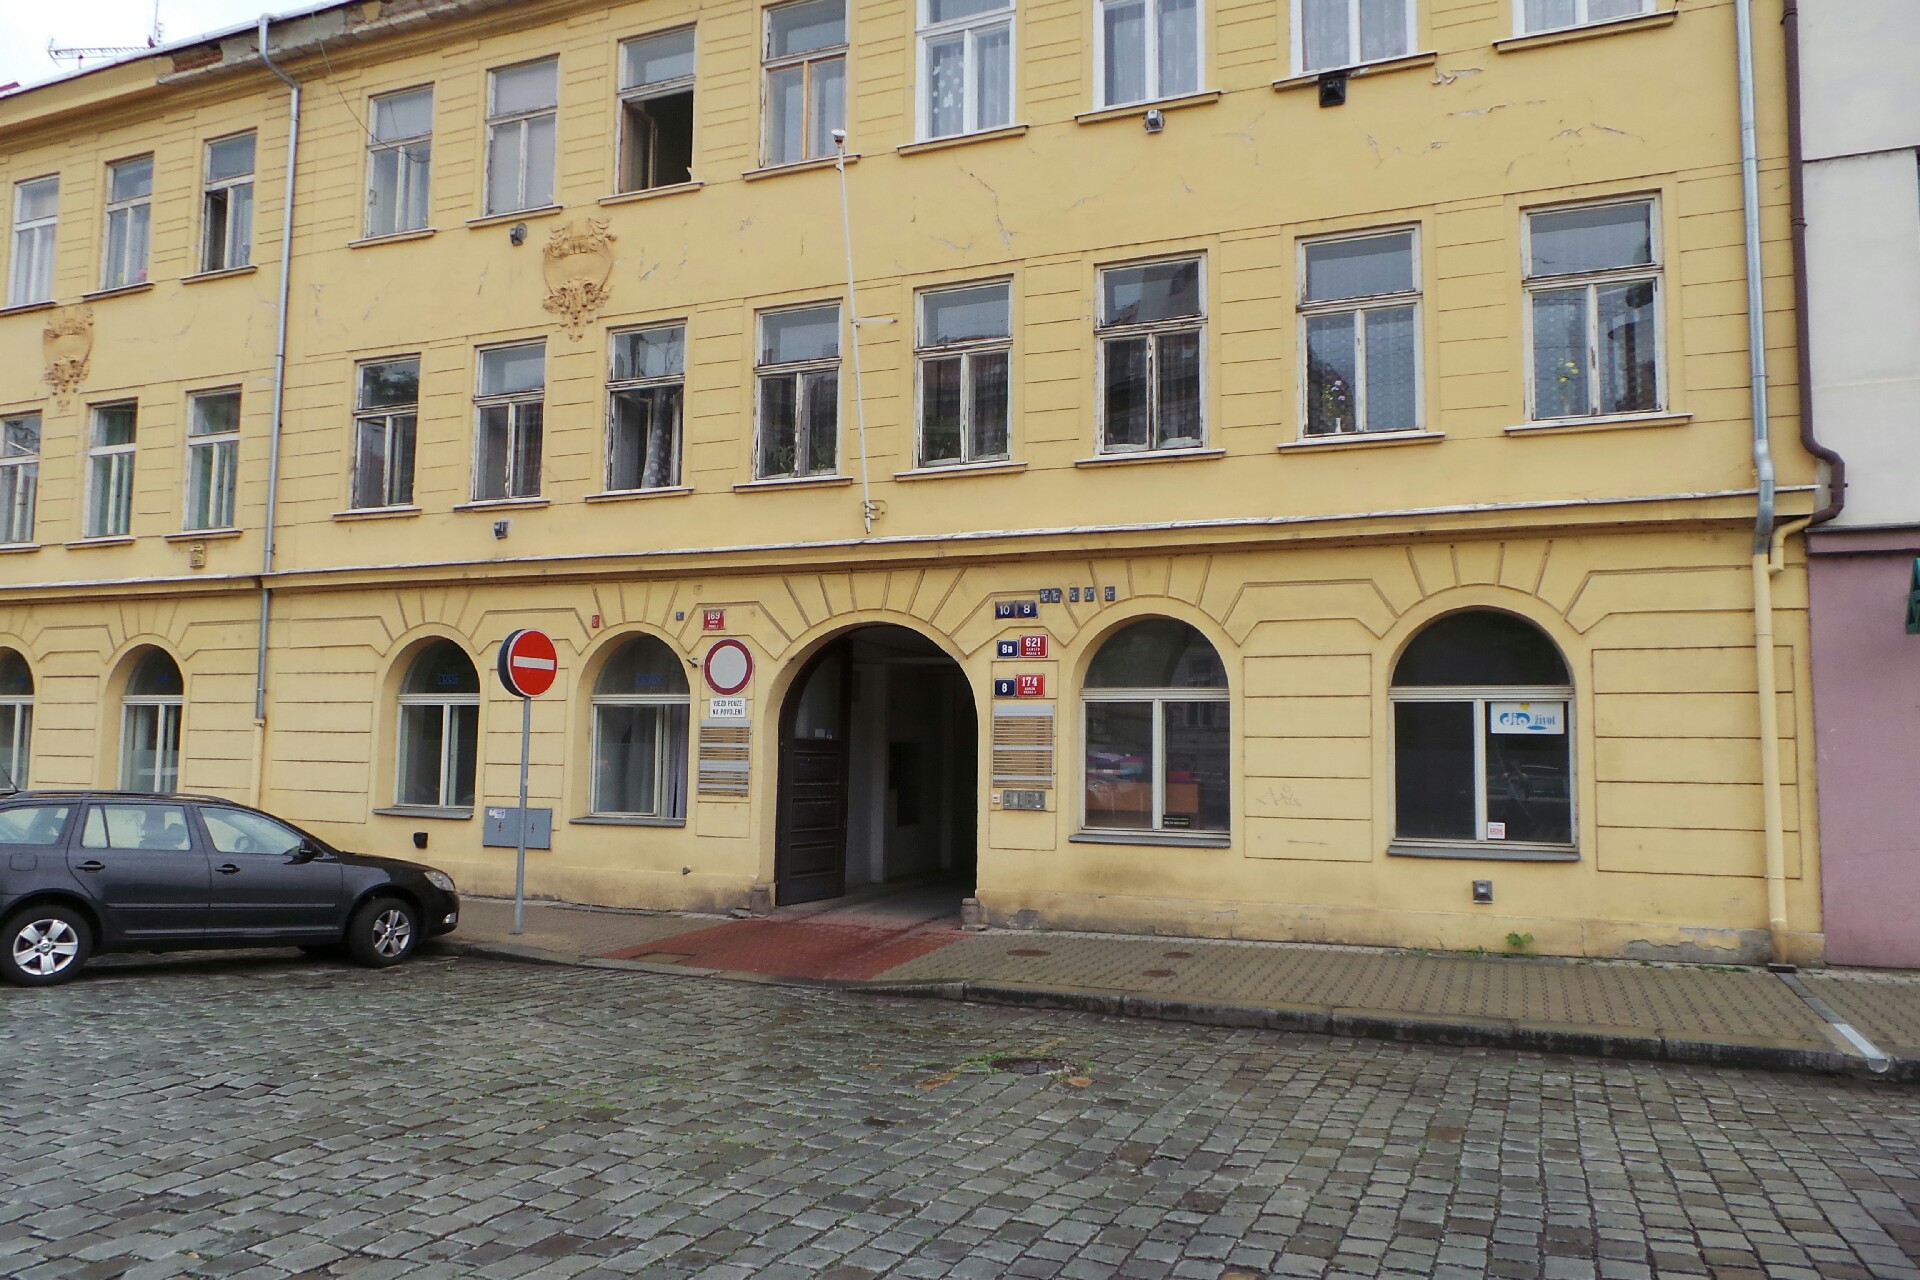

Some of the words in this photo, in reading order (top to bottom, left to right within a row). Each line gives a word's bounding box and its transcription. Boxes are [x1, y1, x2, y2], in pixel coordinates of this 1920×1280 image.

[1000, 606, 1010, 614] 10
[1023, 604, 1030, 614] 8
[708, 611, 720, 620] 169
[1026, 638, 1040, 647] 621
[1002, 644, 1013, 653] 8a
[1022, 676, 1037, 686] 174
[1002, 683, 1007, 693] 8
